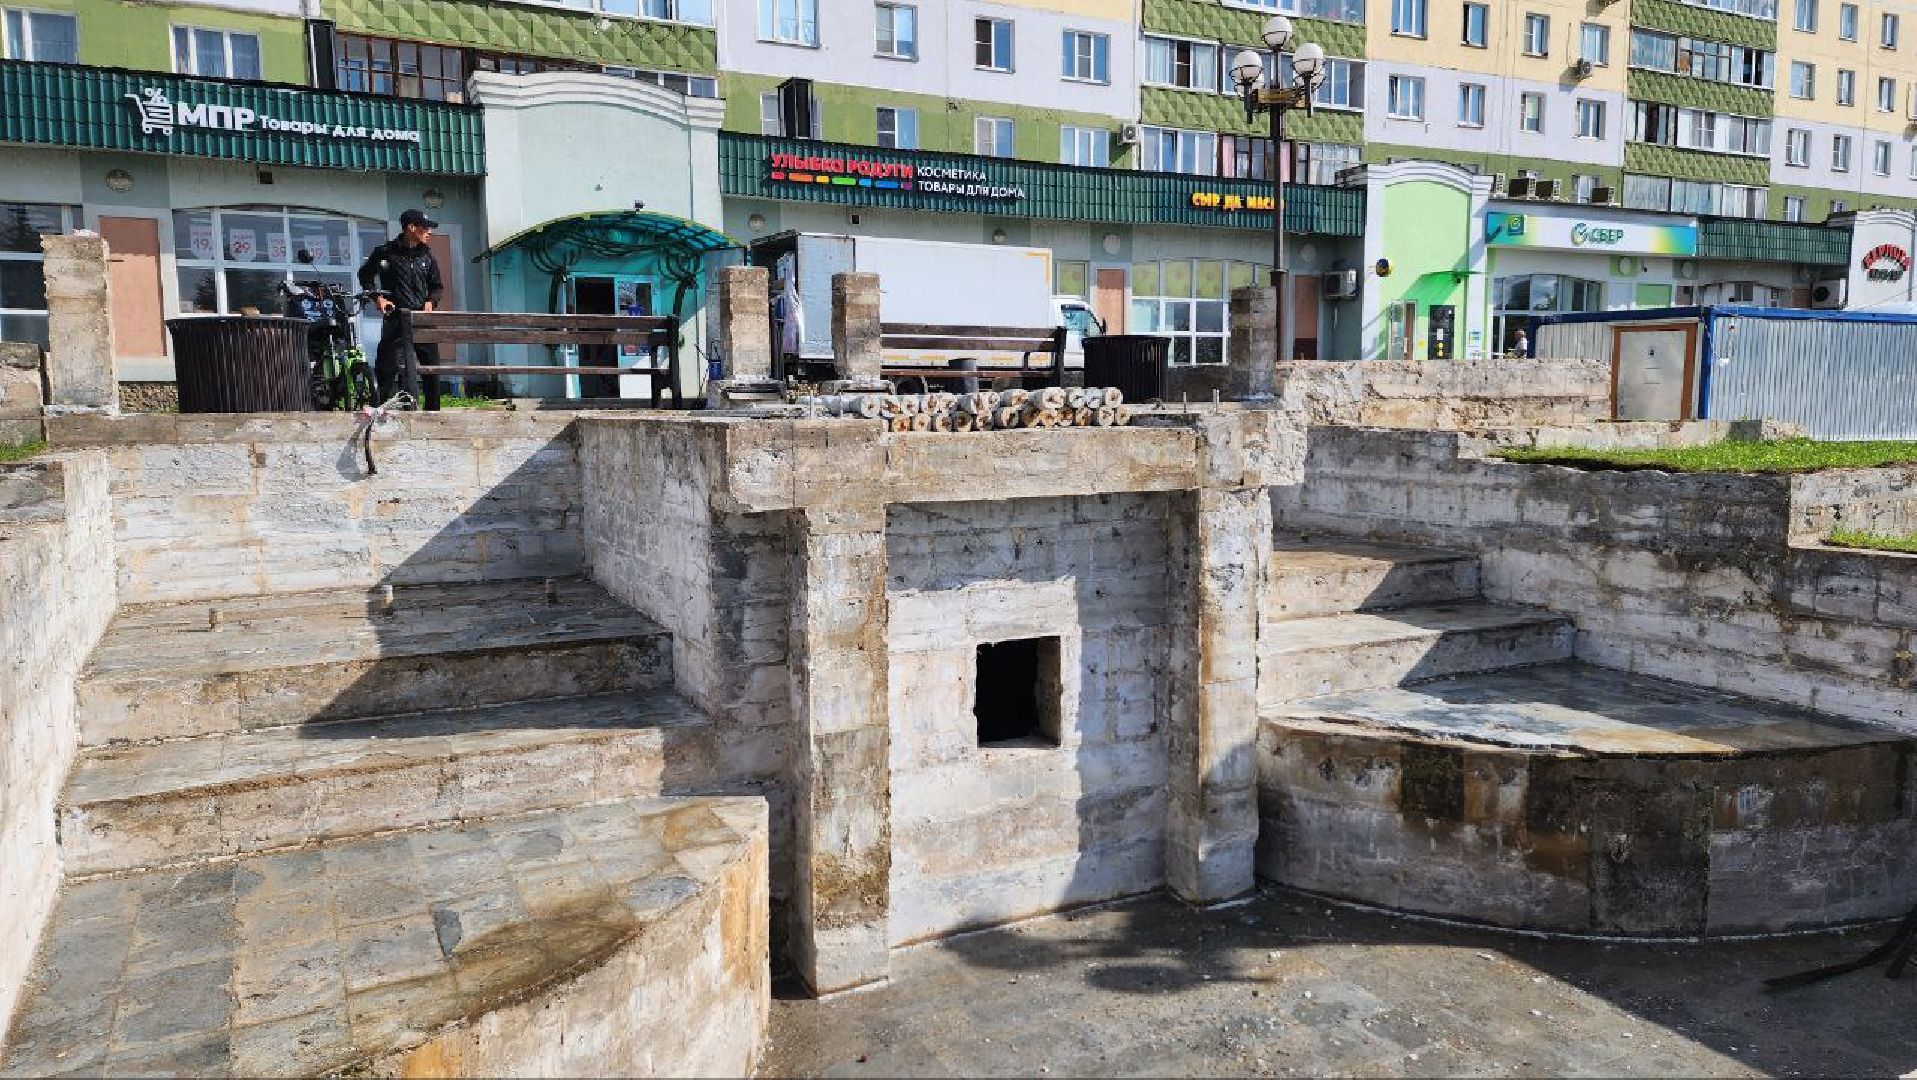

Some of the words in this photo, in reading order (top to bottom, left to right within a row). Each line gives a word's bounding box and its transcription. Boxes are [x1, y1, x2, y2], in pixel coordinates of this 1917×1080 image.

[178, 101, 254, 130] МПР
[260, 115, 327, 135] Товары
[333, 125, 367, 138] для
[371, 128, 420, 142] дома
[917, 166, 987, 181] КОСМЕТИКА
[918, 181, 965, 195] ТОВАРЫ
[966, 184, 989, 197] ДЛЯ
[991, 185, 1026, 199] ДОМА
[1591, 229, 1624, 244] СБЕР
